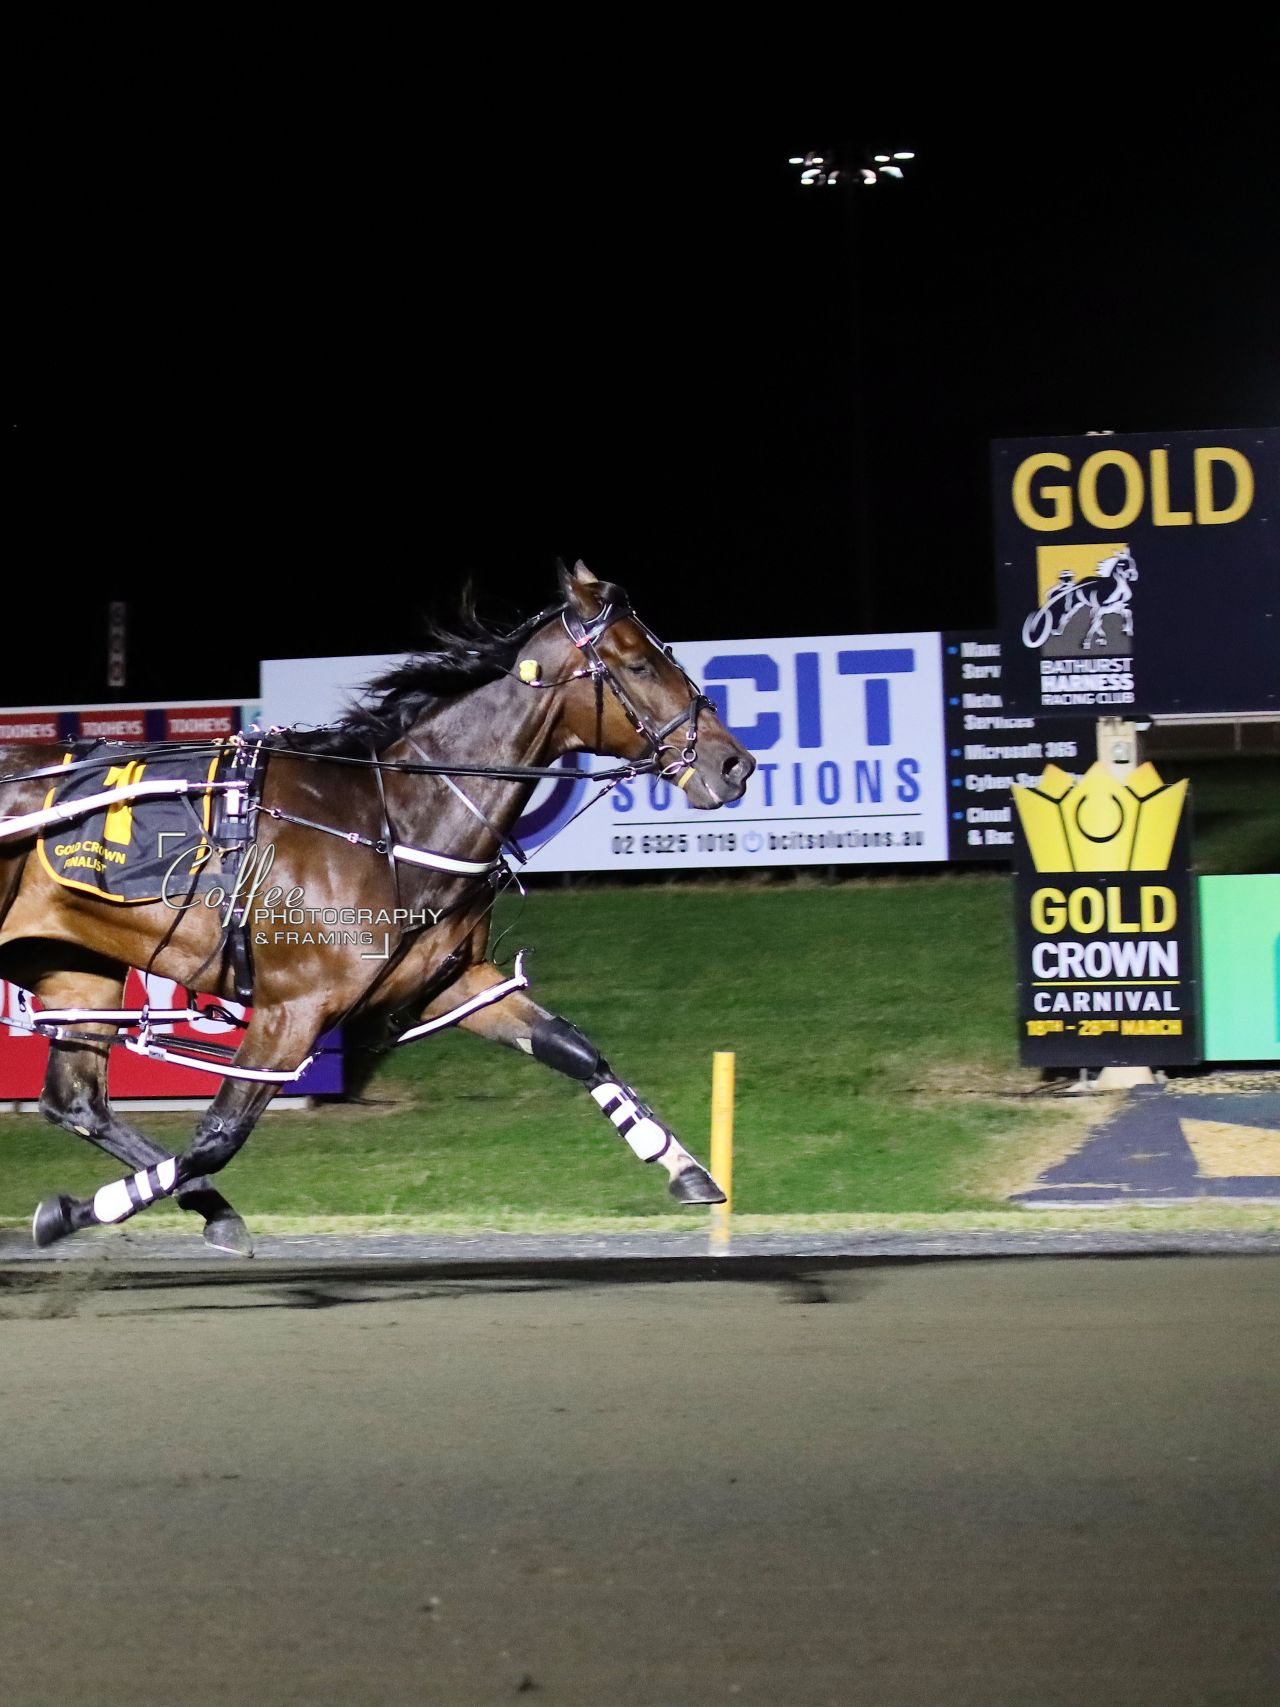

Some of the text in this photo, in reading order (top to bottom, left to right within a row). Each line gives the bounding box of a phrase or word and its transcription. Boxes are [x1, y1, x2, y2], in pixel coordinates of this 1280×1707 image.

[1012, 447, 1255, 532] GOLD
[1040, 658, 1133, 675] BATHURST
[1041, 673, 1134, 692] HARNESS
[704, 648, 915, 750] CIT
[1041, 692, 1135, 705] RACING CLUB
[612, 758, 920, 812] SOTIONS
[55, 840, 126, 865] GOLD CROWN
[612, 834, 635, 854] 02
[64, 856, 107, 874] FINALIST
[1031, 885, 1178, 935] GOLD
[1031, 941, 1179, 979] CROWN
[1033, 991, 1181, 1012] CARNIVAL
[1121, 1019, 1183, 1036] MARCH
